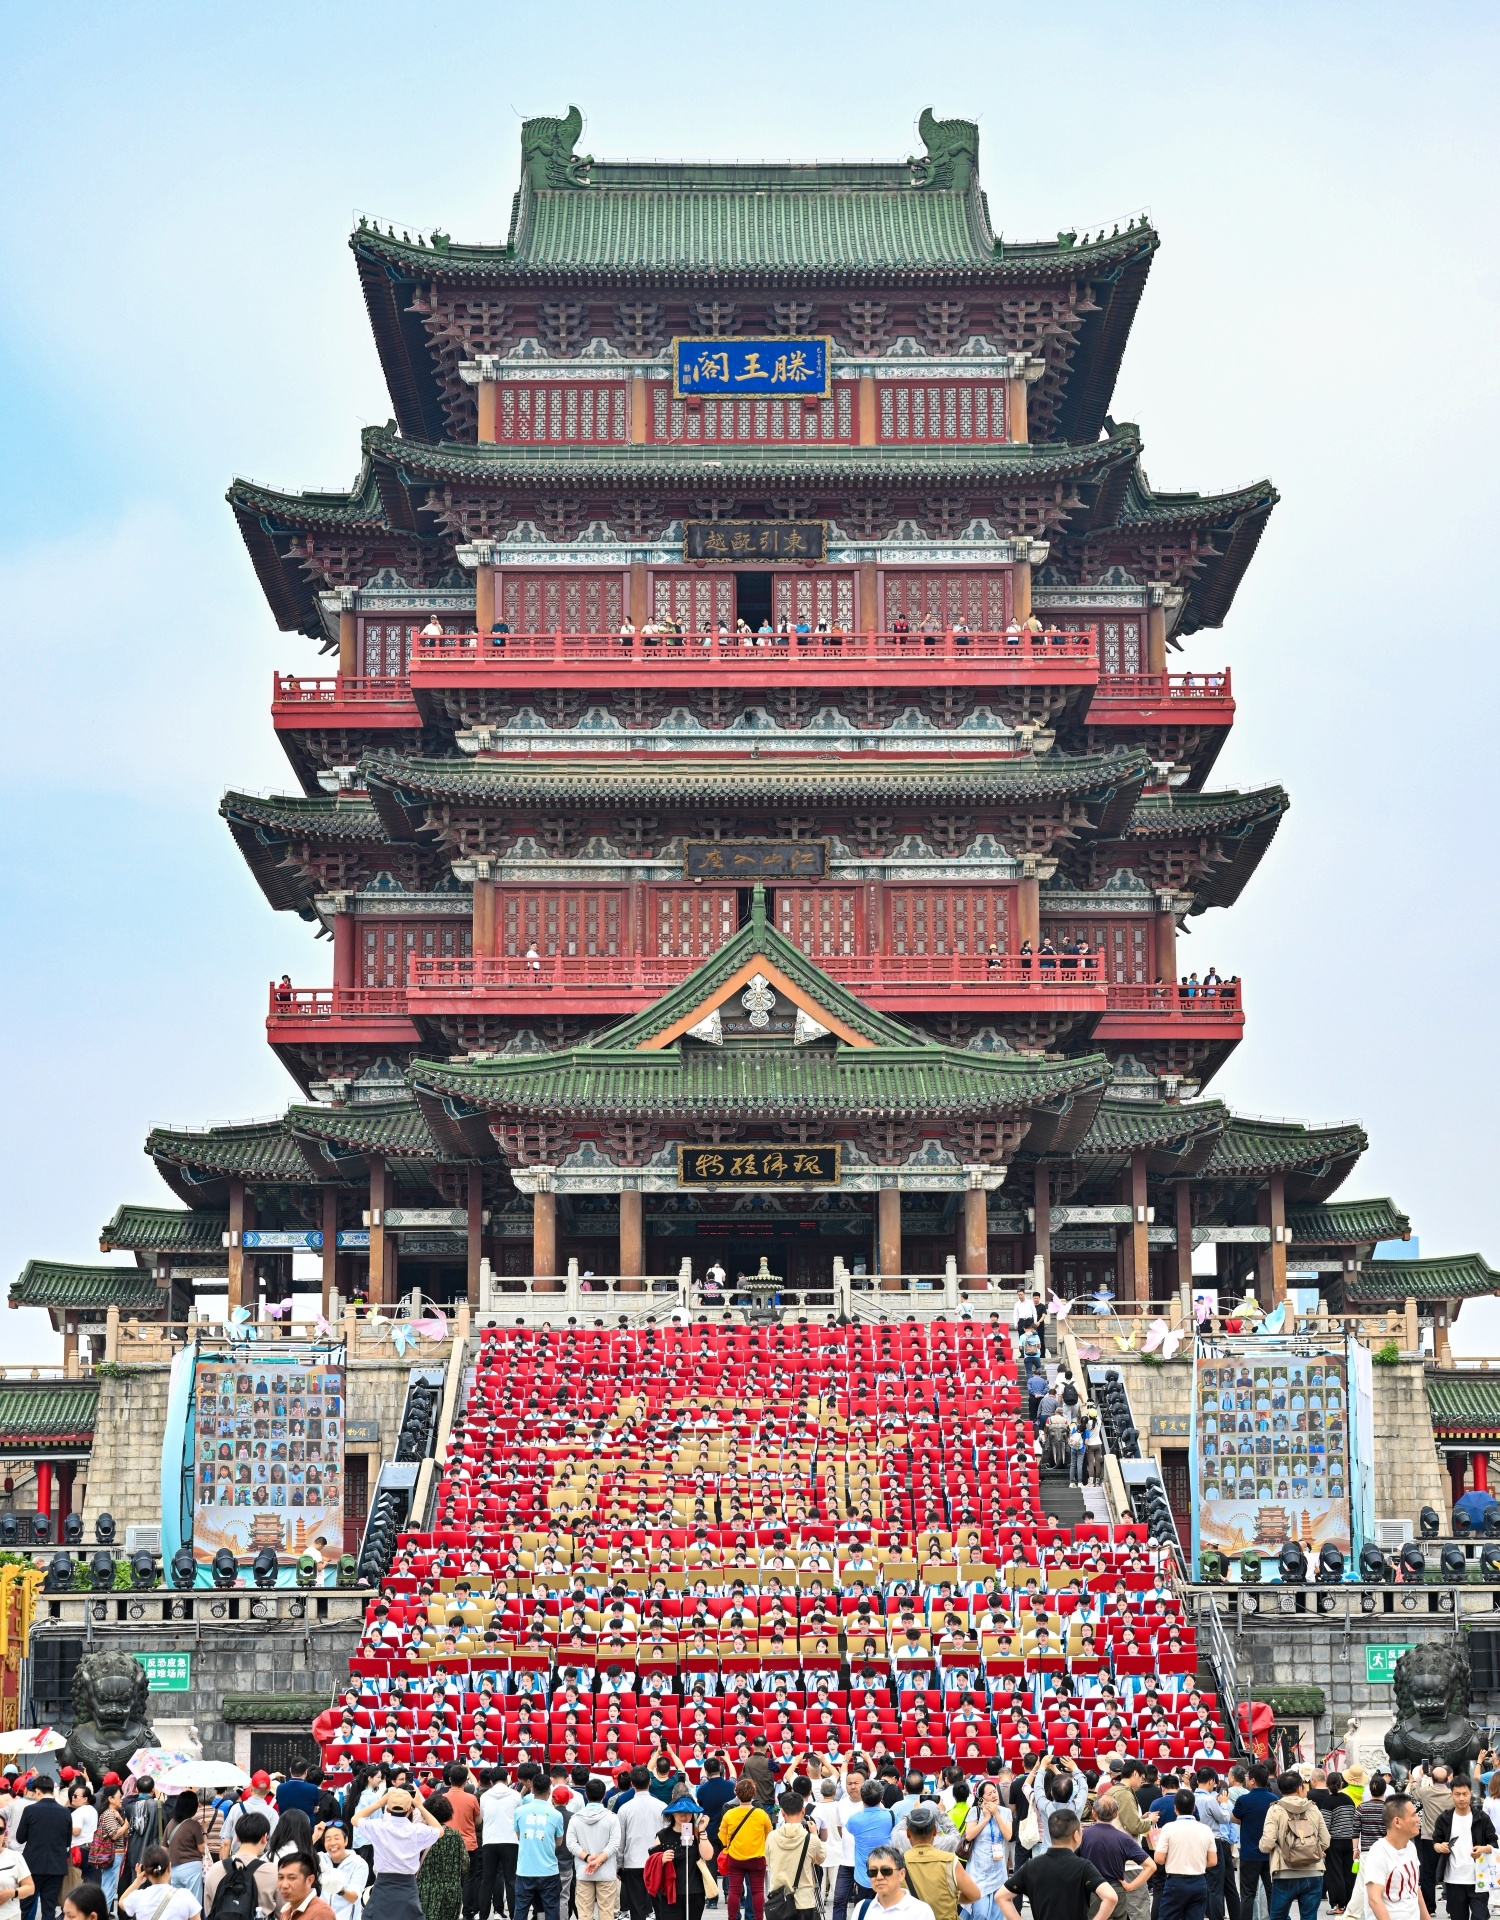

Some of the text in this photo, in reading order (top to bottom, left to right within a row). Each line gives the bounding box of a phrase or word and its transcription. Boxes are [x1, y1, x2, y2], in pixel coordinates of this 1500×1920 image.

[147, 1657, 187, 1668] 反恐应急
[146, 1668, 187, 1679] 避难场所
